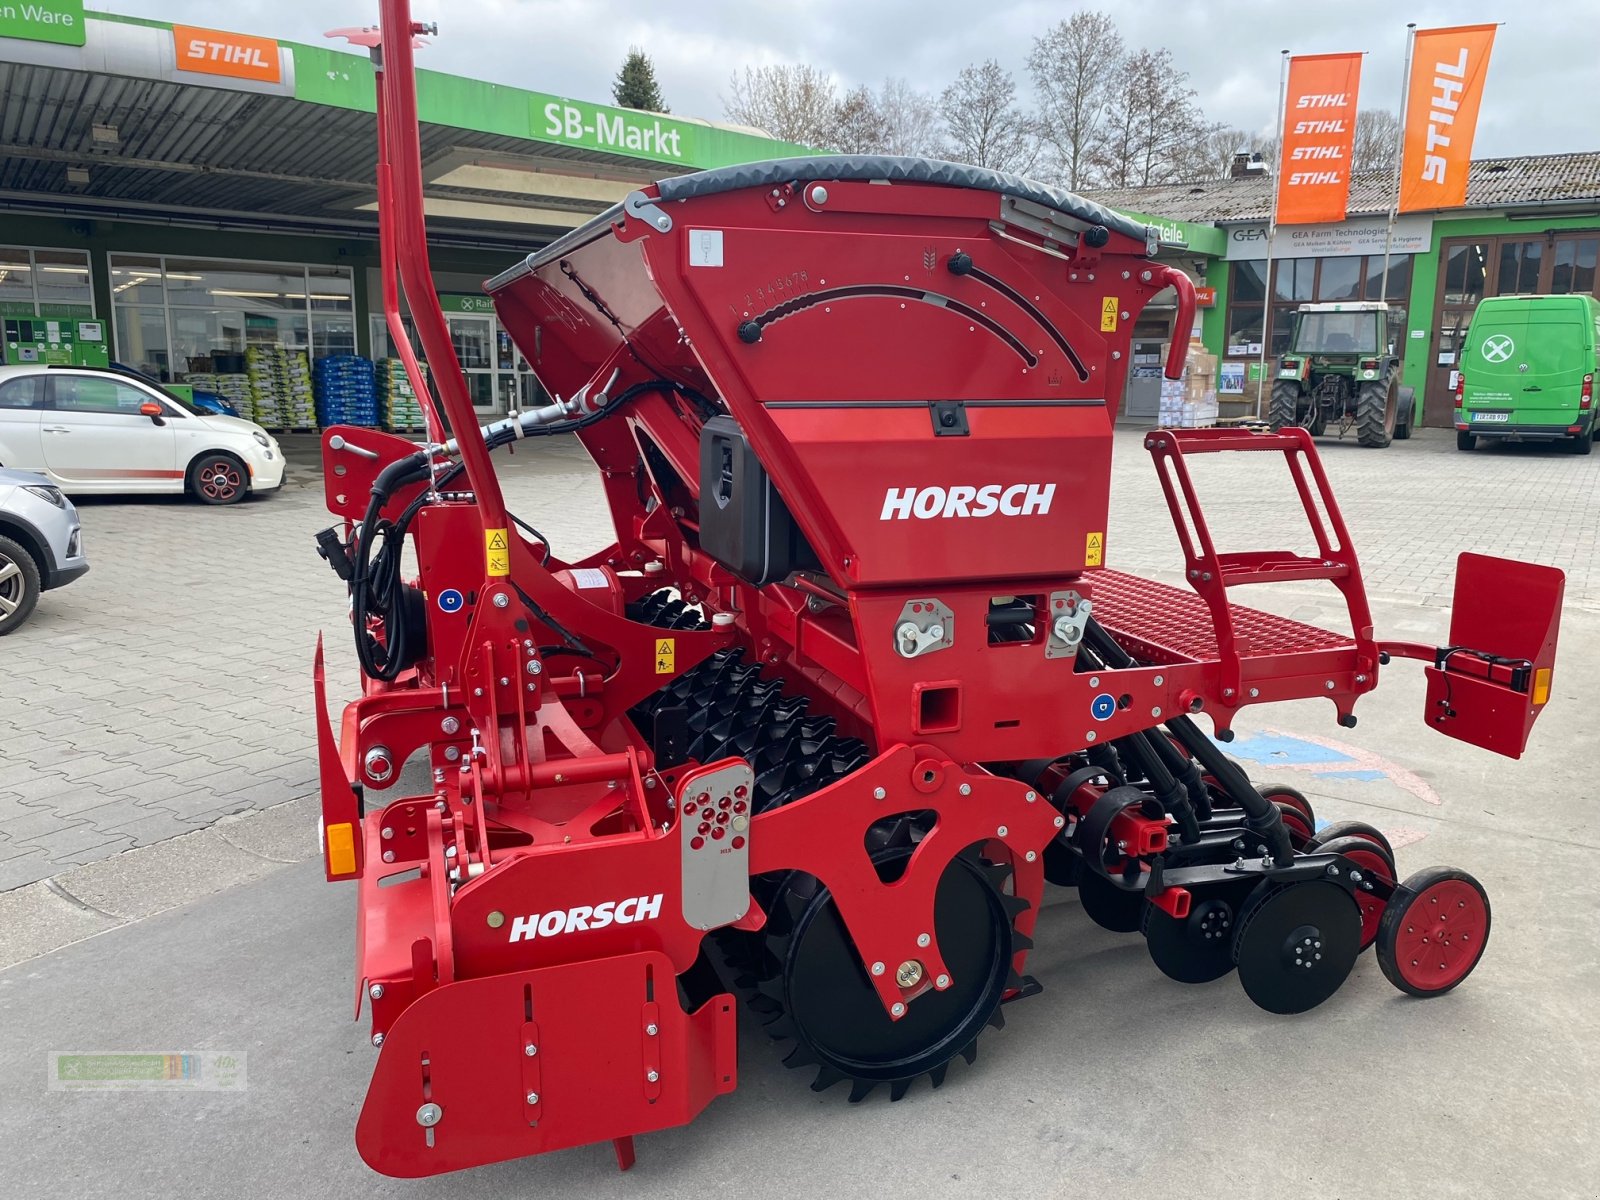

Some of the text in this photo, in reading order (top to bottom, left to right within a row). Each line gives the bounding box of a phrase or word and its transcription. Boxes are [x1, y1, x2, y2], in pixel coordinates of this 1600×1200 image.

[20, 4, 74, 27] Ware
[187, 39, 270, 69] STIHL
[1296, 94, 1349, 109] STIHL
[1420, 47, 1470, 186] STIHL
[544, 102, 682, 158] SB-Markt
[1293, 120, 1346, 135] STIHL
[1290, 146, 1344, 160] STIHL
[1288, 171, 1342, 186] STIHL
[1233, 229, 1268, 242] GEA
[1292, 228, 1390, 239] GEA Farm Technologies
[101, 345, 108, 354] 2
[879, 482, 1057, 522] HORSCH
[509, 893, 664, 944] HORSCH
